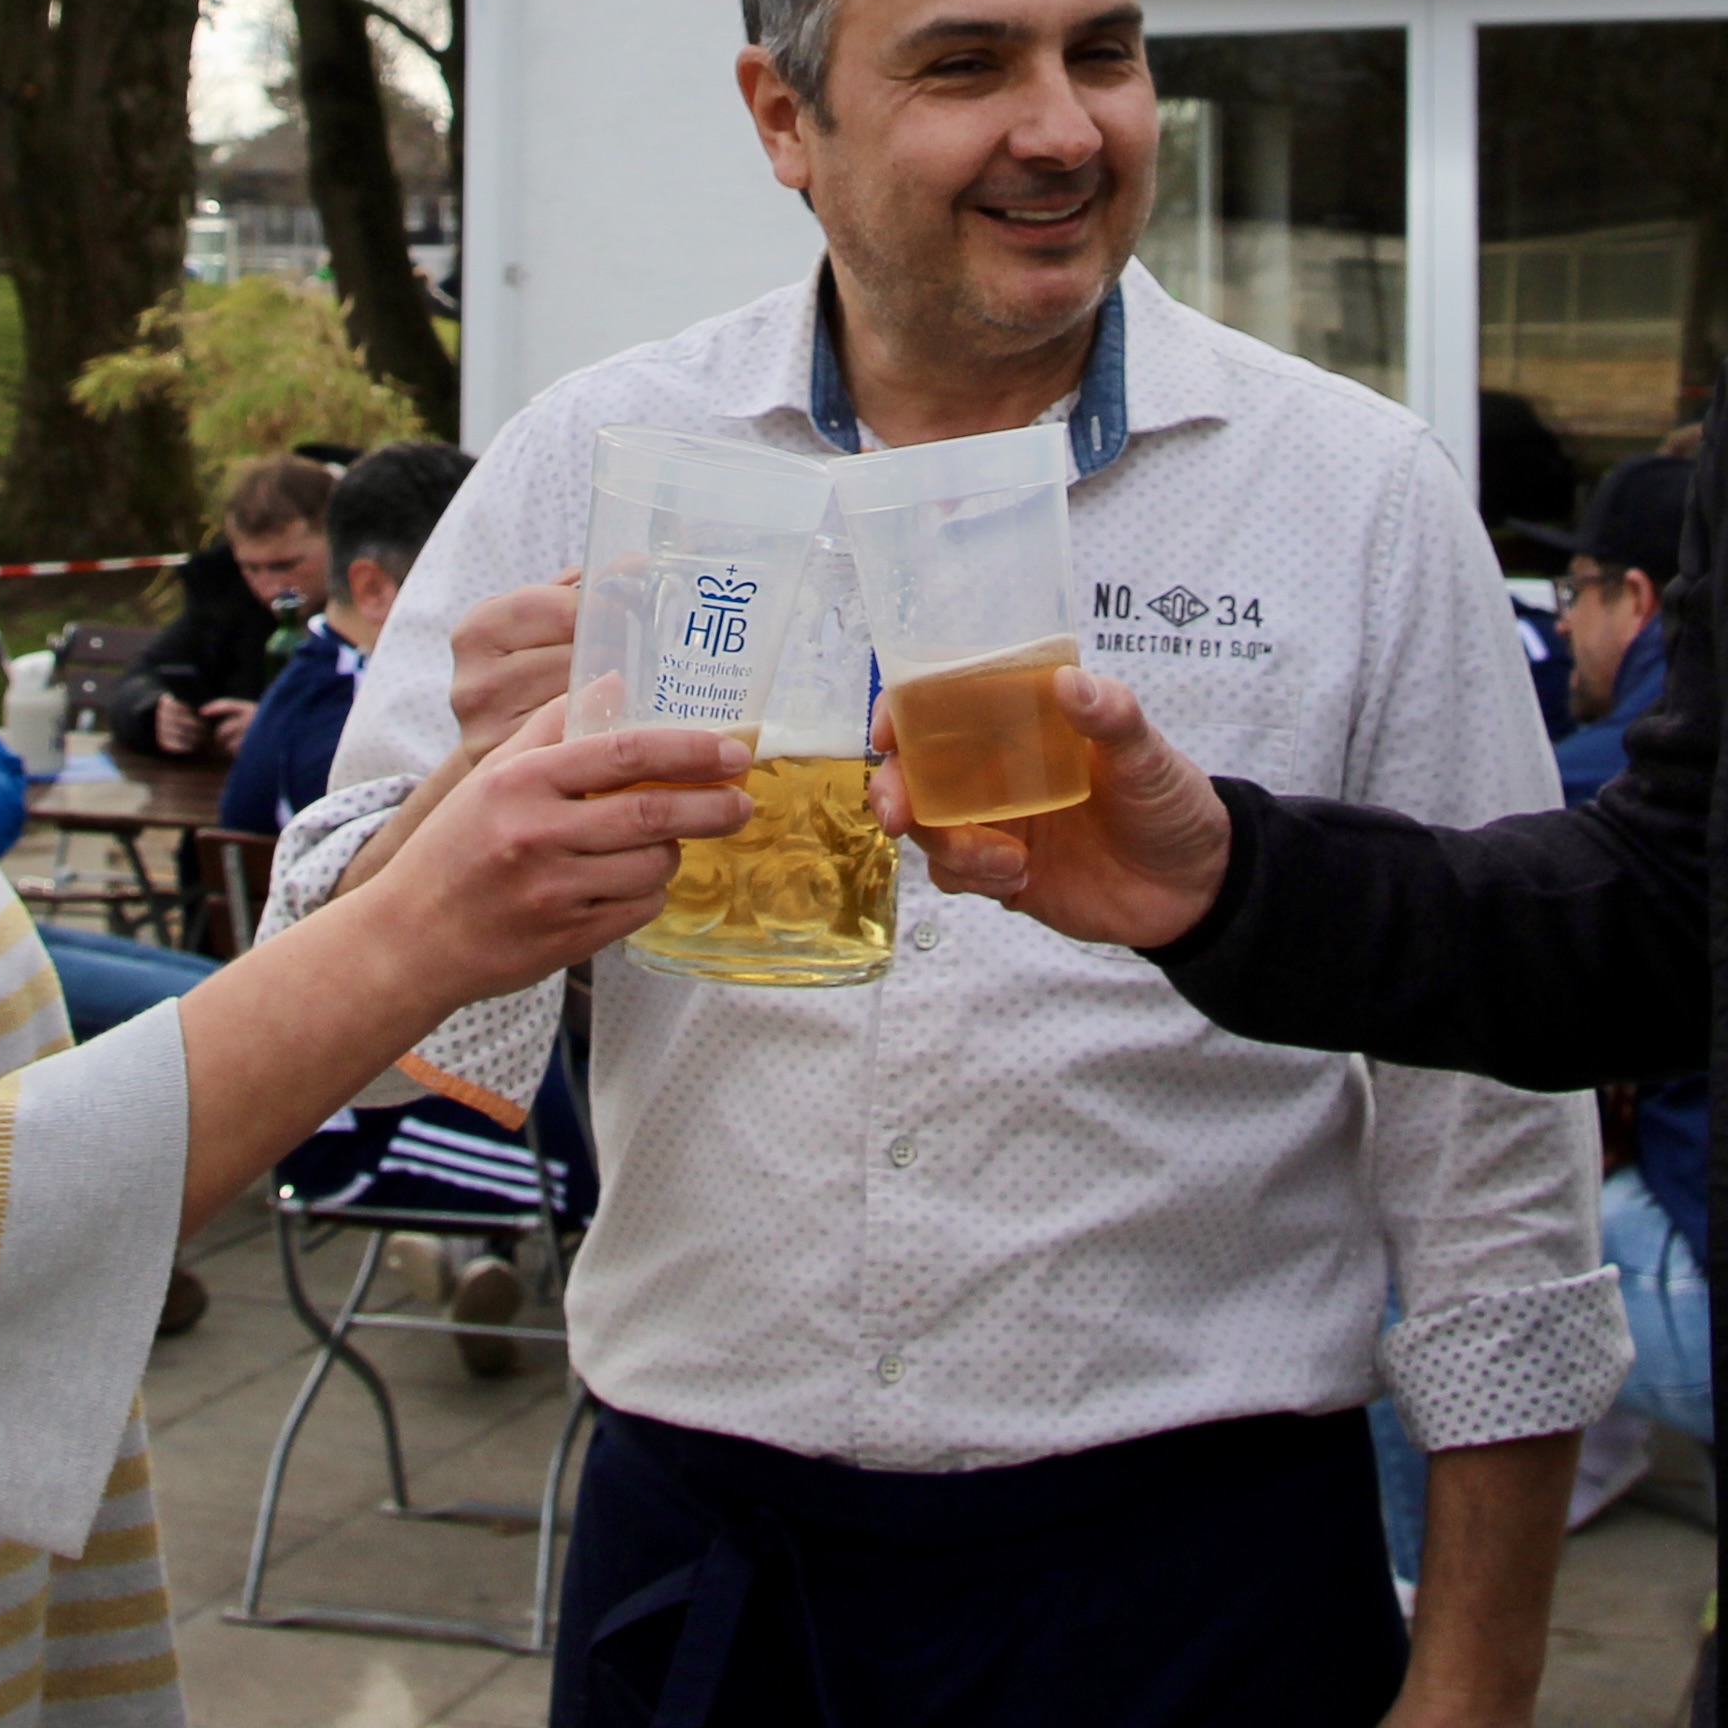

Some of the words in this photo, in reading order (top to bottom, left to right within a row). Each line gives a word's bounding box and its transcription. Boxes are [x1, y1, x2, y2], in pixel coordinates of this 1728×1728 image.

[1093, 582, 1141, 620] NO.
[1216, 595, 1264, 628] 34
[683, 603, 748, 658] HTB
[1096, 632, 1192, 657] DIRECTORY
[1200, 639, 1222, 658] BY
[656, 673, 748, 702] Brauhaus
